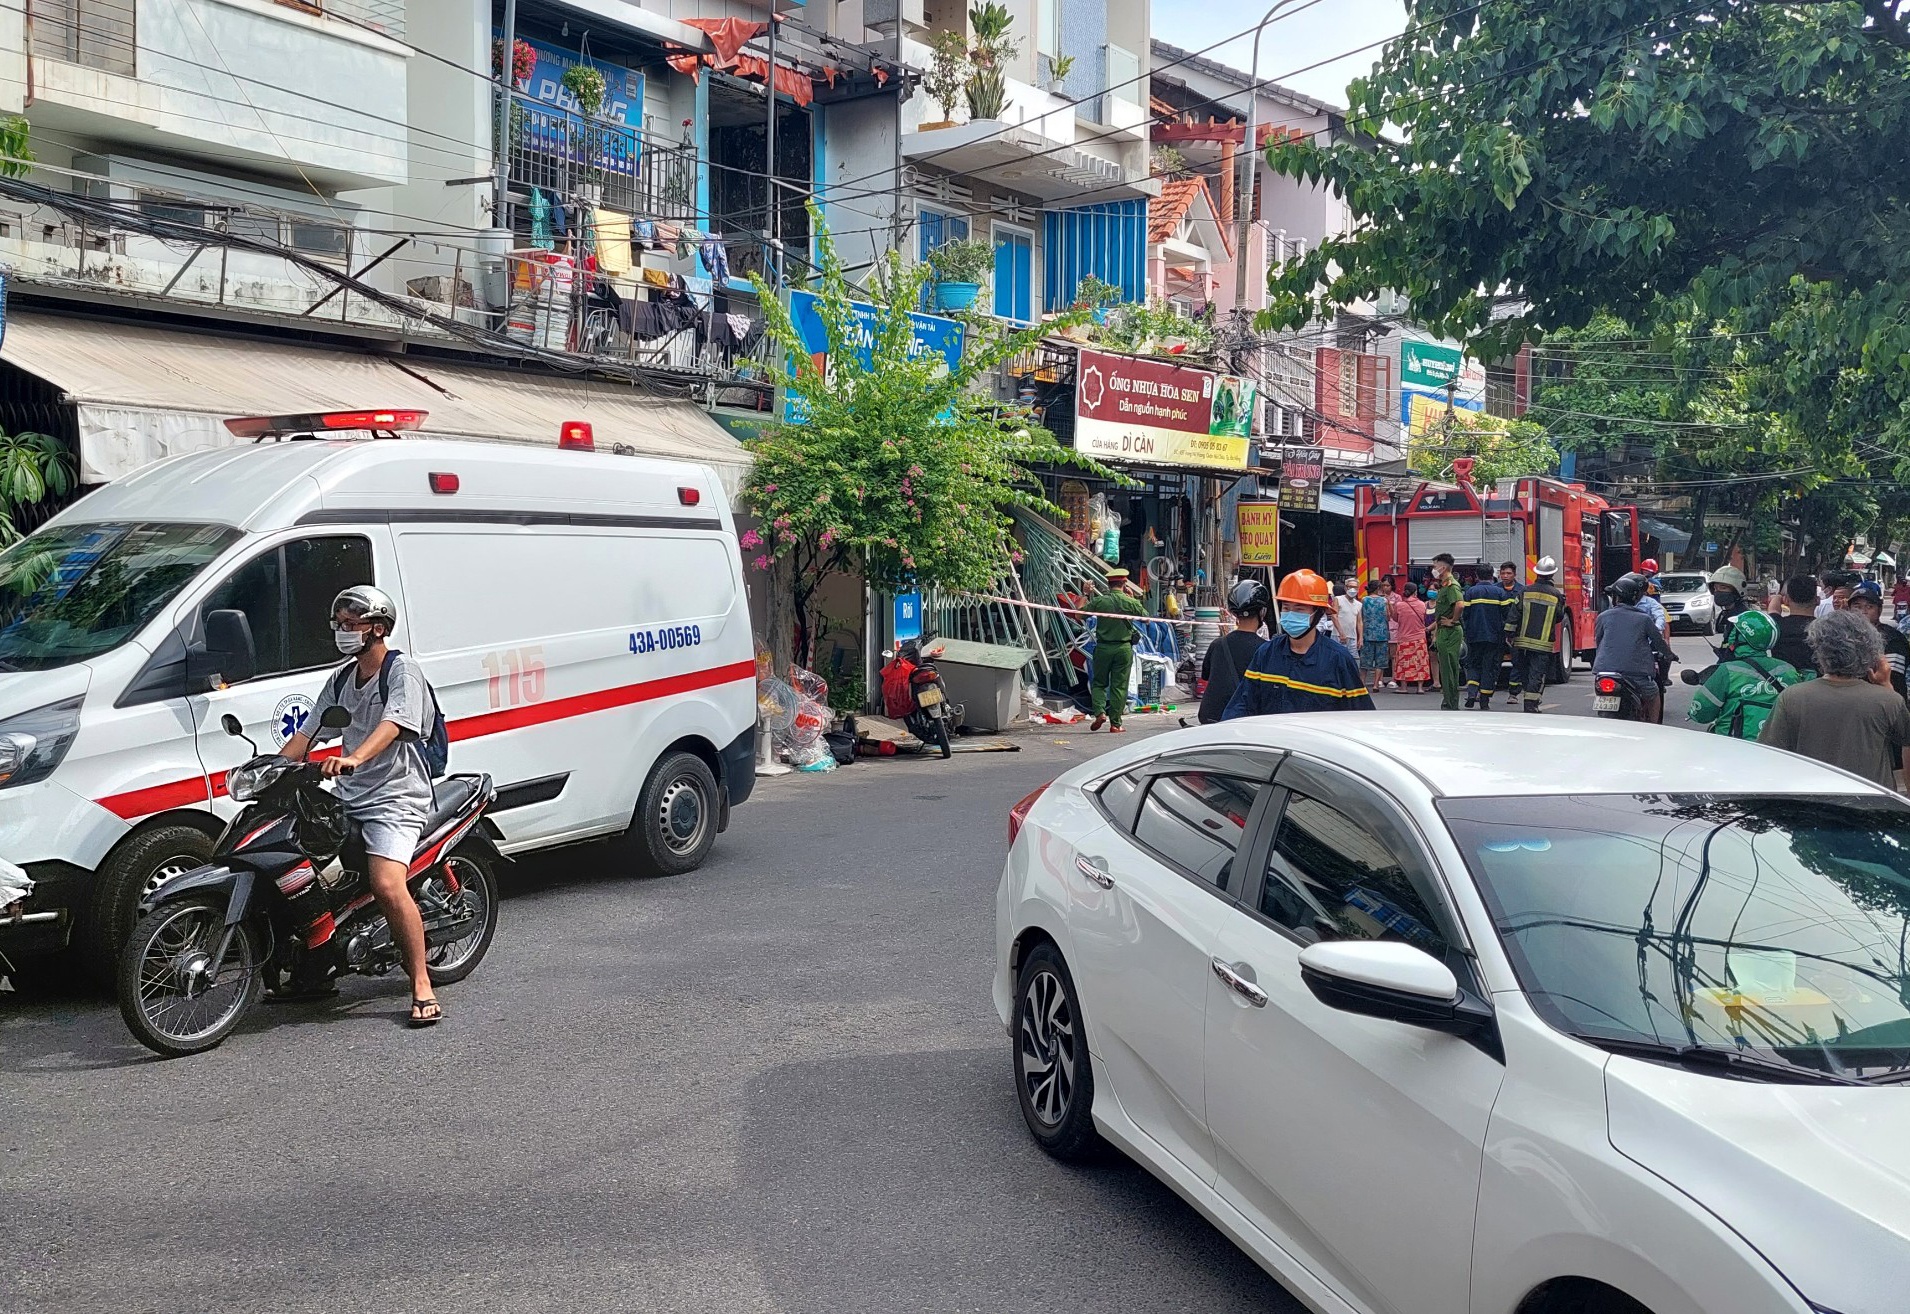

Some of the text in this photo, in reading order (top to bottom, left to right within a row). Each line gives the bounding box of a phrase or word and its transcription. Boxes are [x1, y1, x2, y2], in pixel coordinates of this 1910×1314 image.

[1109, 370, 1130, 392] ỐNG
[1132, 379, 1158, 398] NHỰA
[1181, 388, 1199, 403] SEN
[1119, 398, 1133, 412] Dẫn
[1154, 404, 1171, 419] hạnh
[1171, 408, 1188, 420] phúc
[1122, 431, 1132, 452] DÌ
[1241, 509, 1260, 526] BÁNH
[1240, 532, 1274, 548] HEO QUAY
[629, 624, 701, 655] 43A-00569
[1741, 621, 1755, 637] Grab
[480, 645, 546, 710] 115
